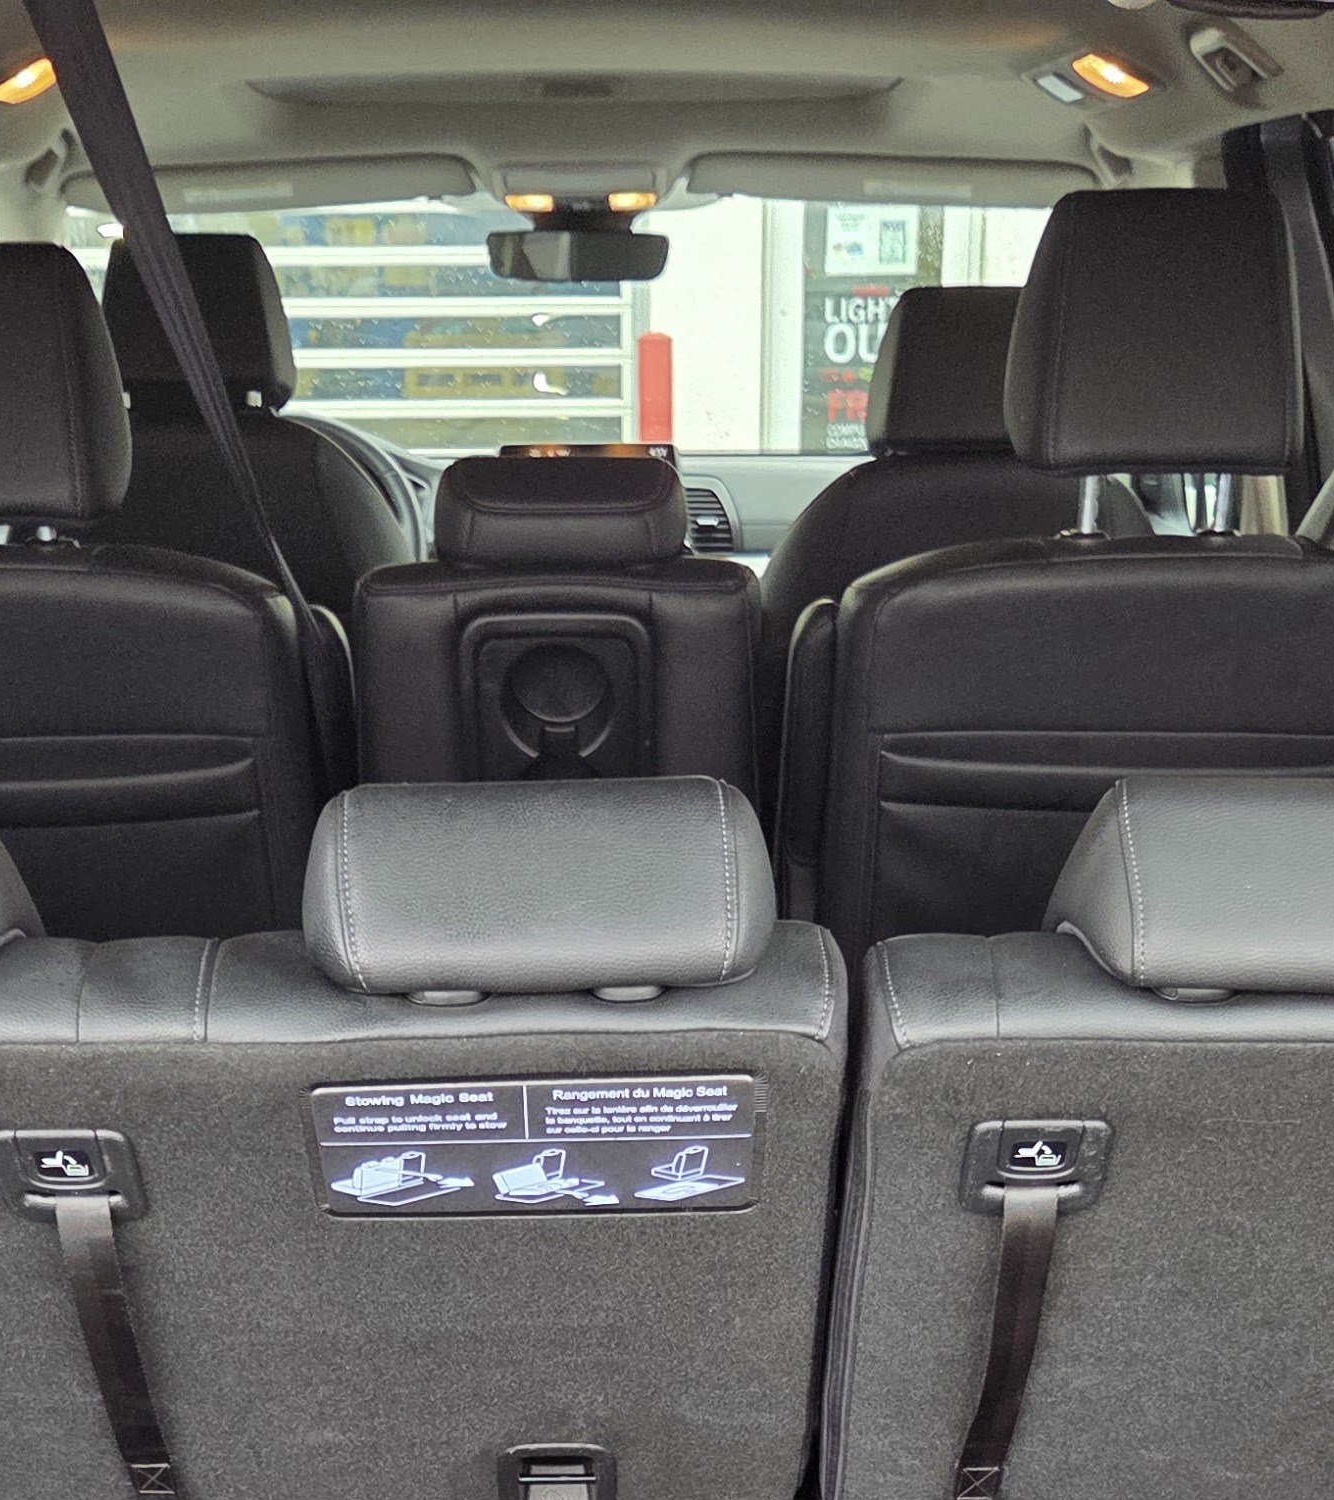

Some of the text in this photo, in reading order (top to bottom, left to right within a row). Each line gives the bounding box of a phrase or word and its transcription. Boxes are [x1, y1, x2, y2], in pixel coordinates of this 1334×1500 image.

[344, 1091, 494, 1107] Stowing Magic Seat
[552, 1085, 728, 1102] Rangement du Magic Seat
[333, 1116, 356, 1126] Pull
[391, 1116, 403, 1124] to
[405, 1113, 443, 1123] unlock
[445, 1112, 471, 1122] seat
[474, 1112, 498, 1121] and
[612, 1115, 632, 1124] tout
[633, 1115, 647, 1123] en
[428, 1122, 464, 1132] firmly
[465, 1122, 477, 1130] to
[478, 1121, 508, 1130] stow
[601, 1125, 625, 1135] pour
